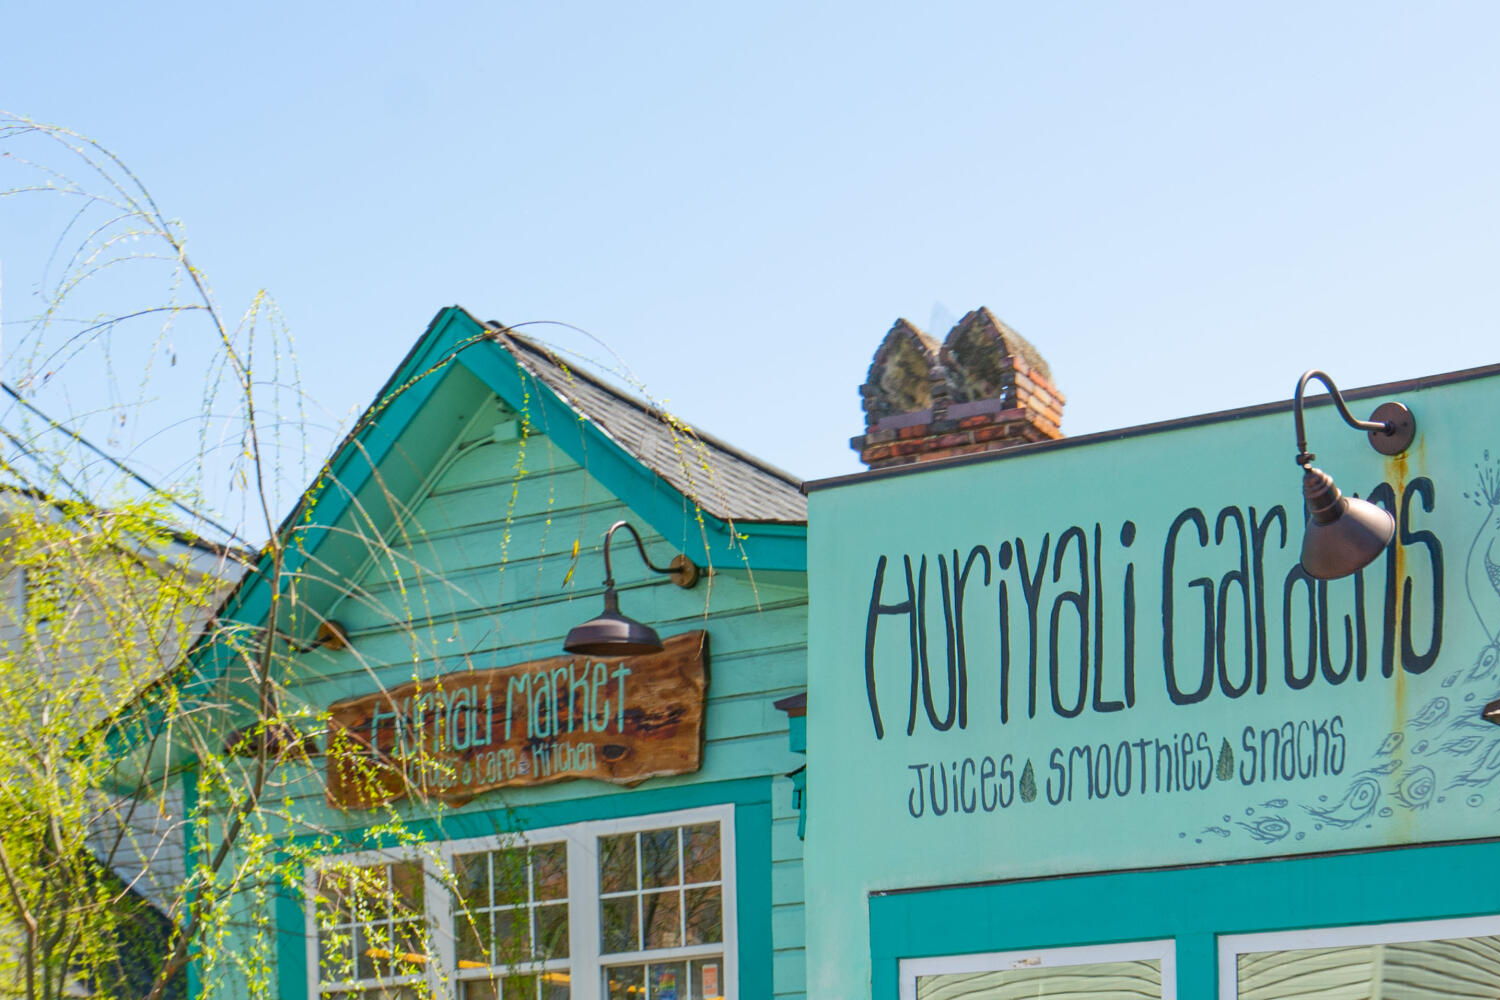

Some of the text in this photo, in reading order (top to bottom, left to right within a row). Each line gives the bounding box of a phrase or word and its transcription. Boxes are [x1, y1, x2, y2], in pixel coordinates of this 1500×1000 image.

[504, 659, 632, 741] Market
[531, 740, 597, 779] Kitchen
[1046, 731, 1214, 806] Smoothies
[1239, 715, 1346, 786] Snacks
